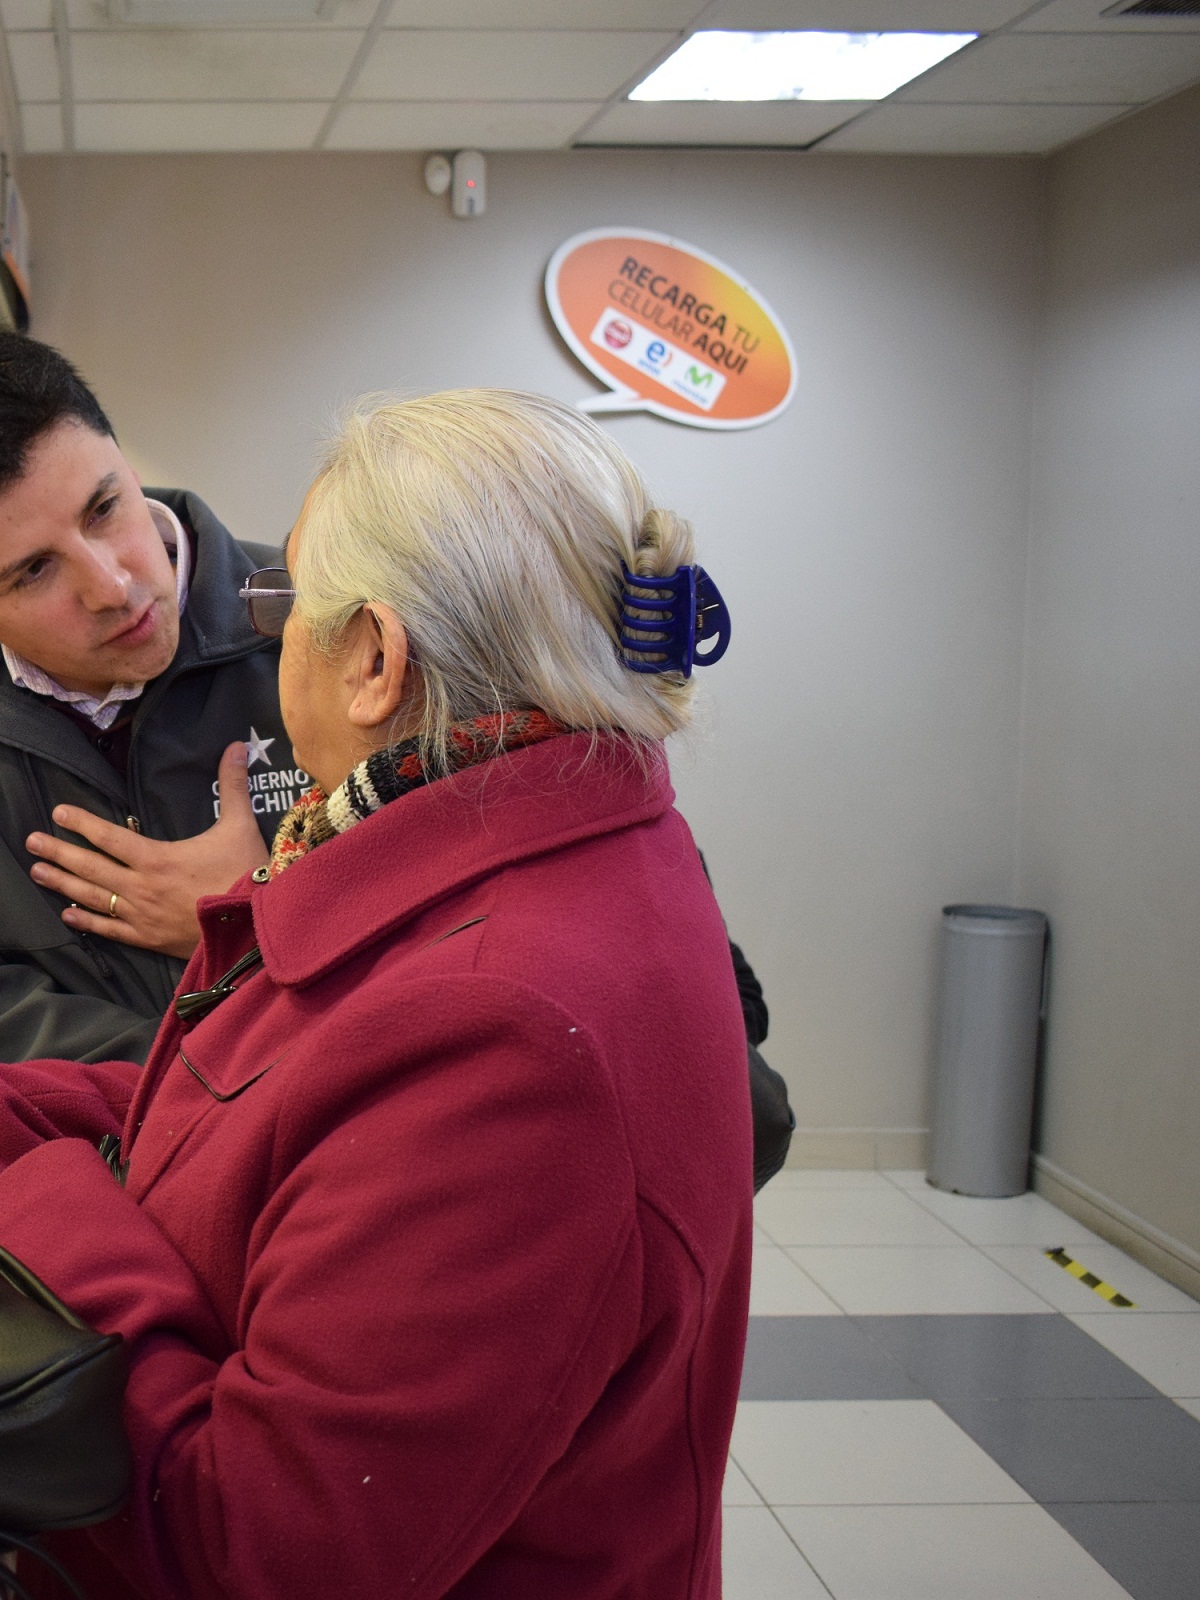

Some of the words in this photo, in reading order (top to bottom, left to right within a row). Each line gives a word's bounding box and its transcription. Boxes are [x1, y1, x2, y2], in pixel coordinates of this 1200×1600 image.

[608, 279, 695, 343] CELULAR
[692, 335, 749, 375] AQUI
[620, 257, 727, 335] RECARGA
[733, 326, 761, 354] TU
